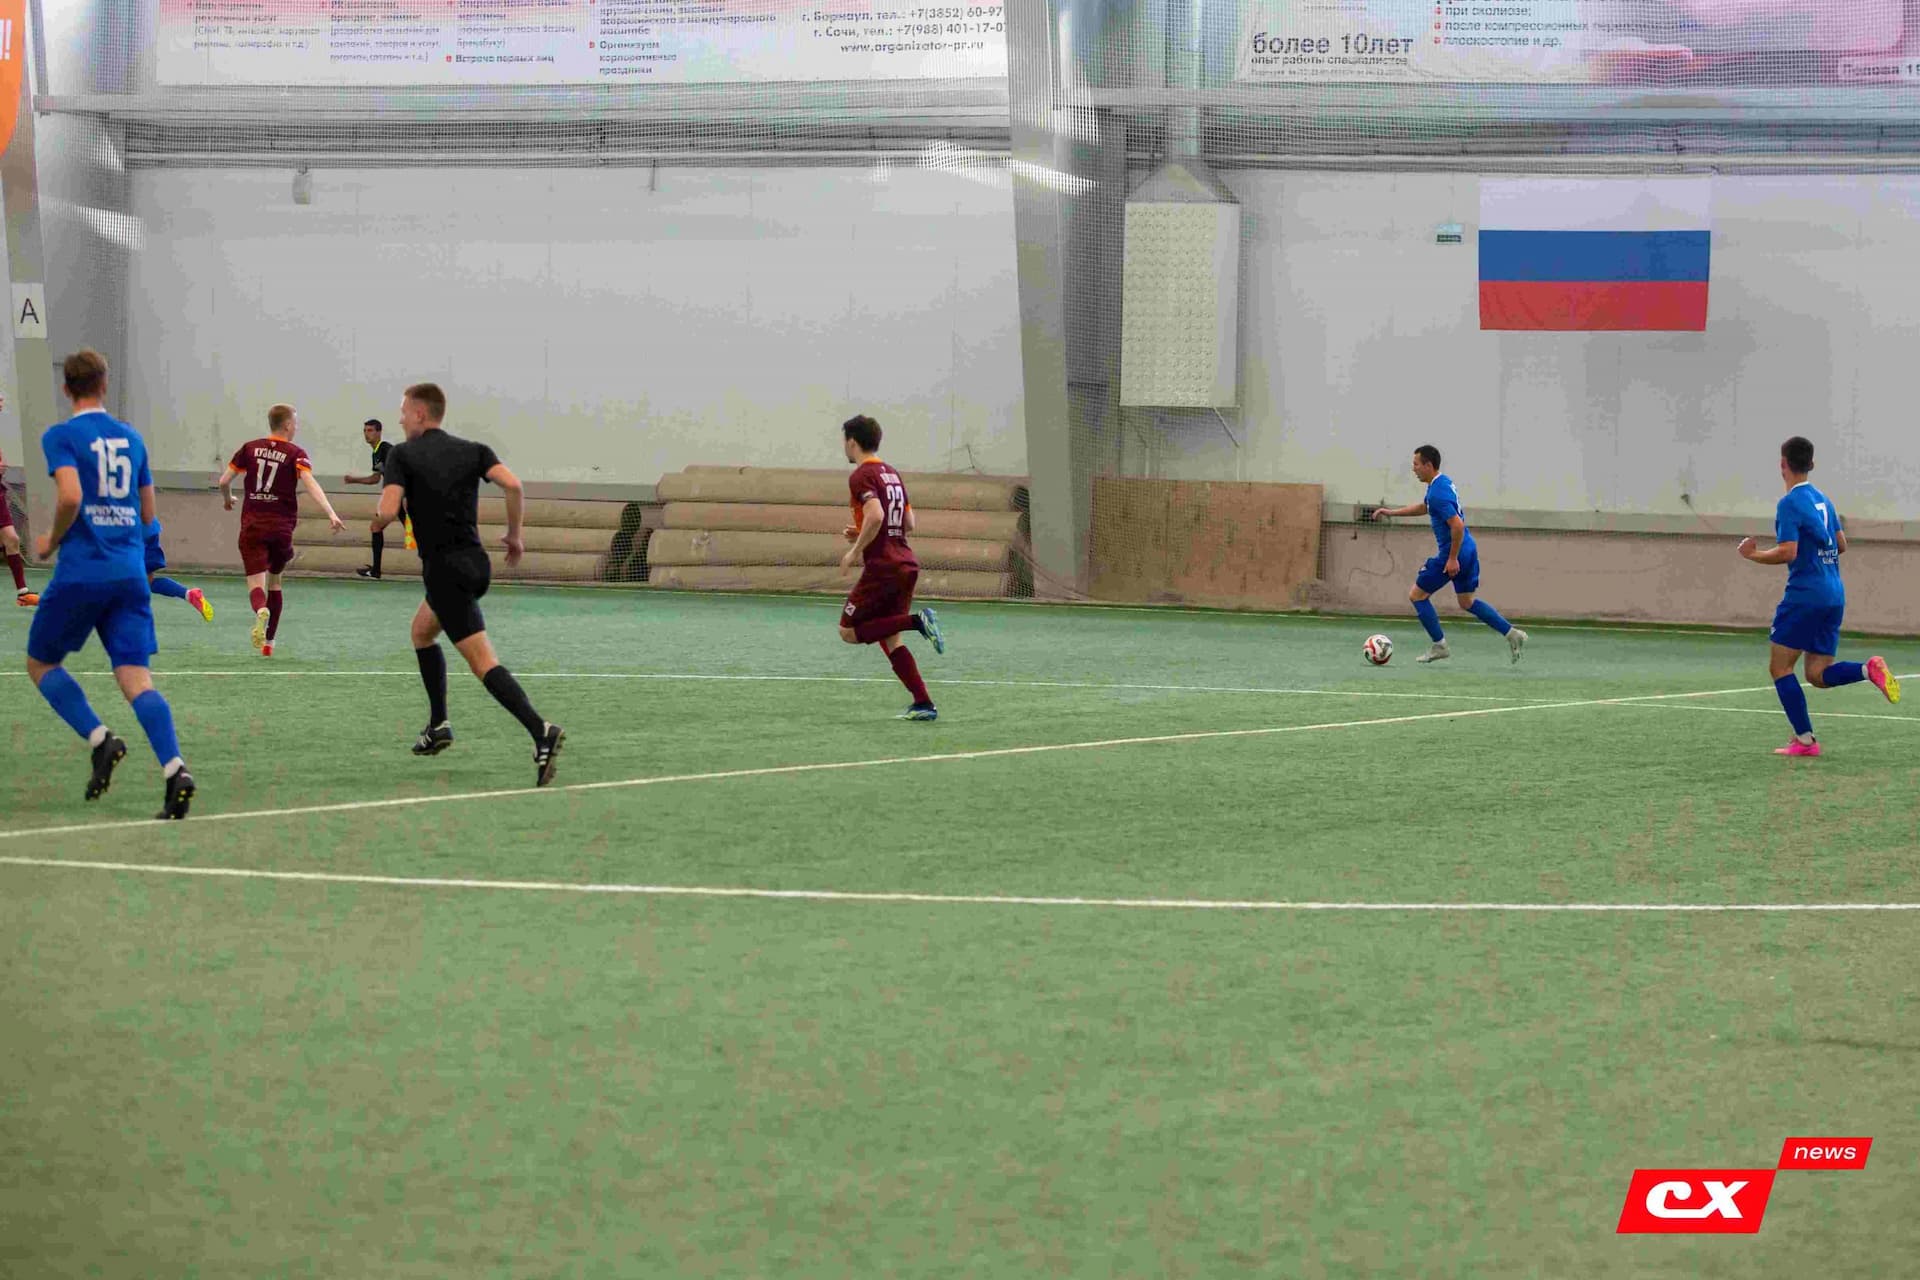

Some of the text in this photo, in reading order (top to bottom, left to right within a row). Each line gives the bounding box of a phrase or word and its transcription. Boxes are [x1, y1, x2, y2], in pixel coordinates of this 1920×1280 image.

[813, 11, 873, 23] Барнаул,
[910, 8, 963, 20] +7(3852)
[1445, 6, 1532, 16] при сколиозе;
[813, 29, 822, 37] г.
[826, 27, 860, 38] Сочи,
[1445, 22, 1481, 31] после
[1484, 22, 1589, 32] компрессионных
[840, 40, 984, 53] www.organizator-pr.ru
[1253, 31, 1414, 54] более 10лет
[1444, 36, 1562, 48] плоскостопие и др.
[1251, 56, 1280, 65] опыт
[1282, 54, 1325, 66] работы
[90, 436, 132, 499] 15
[255, 458, 279, 493] 17
[1815, 502, 1833, 546] 7
